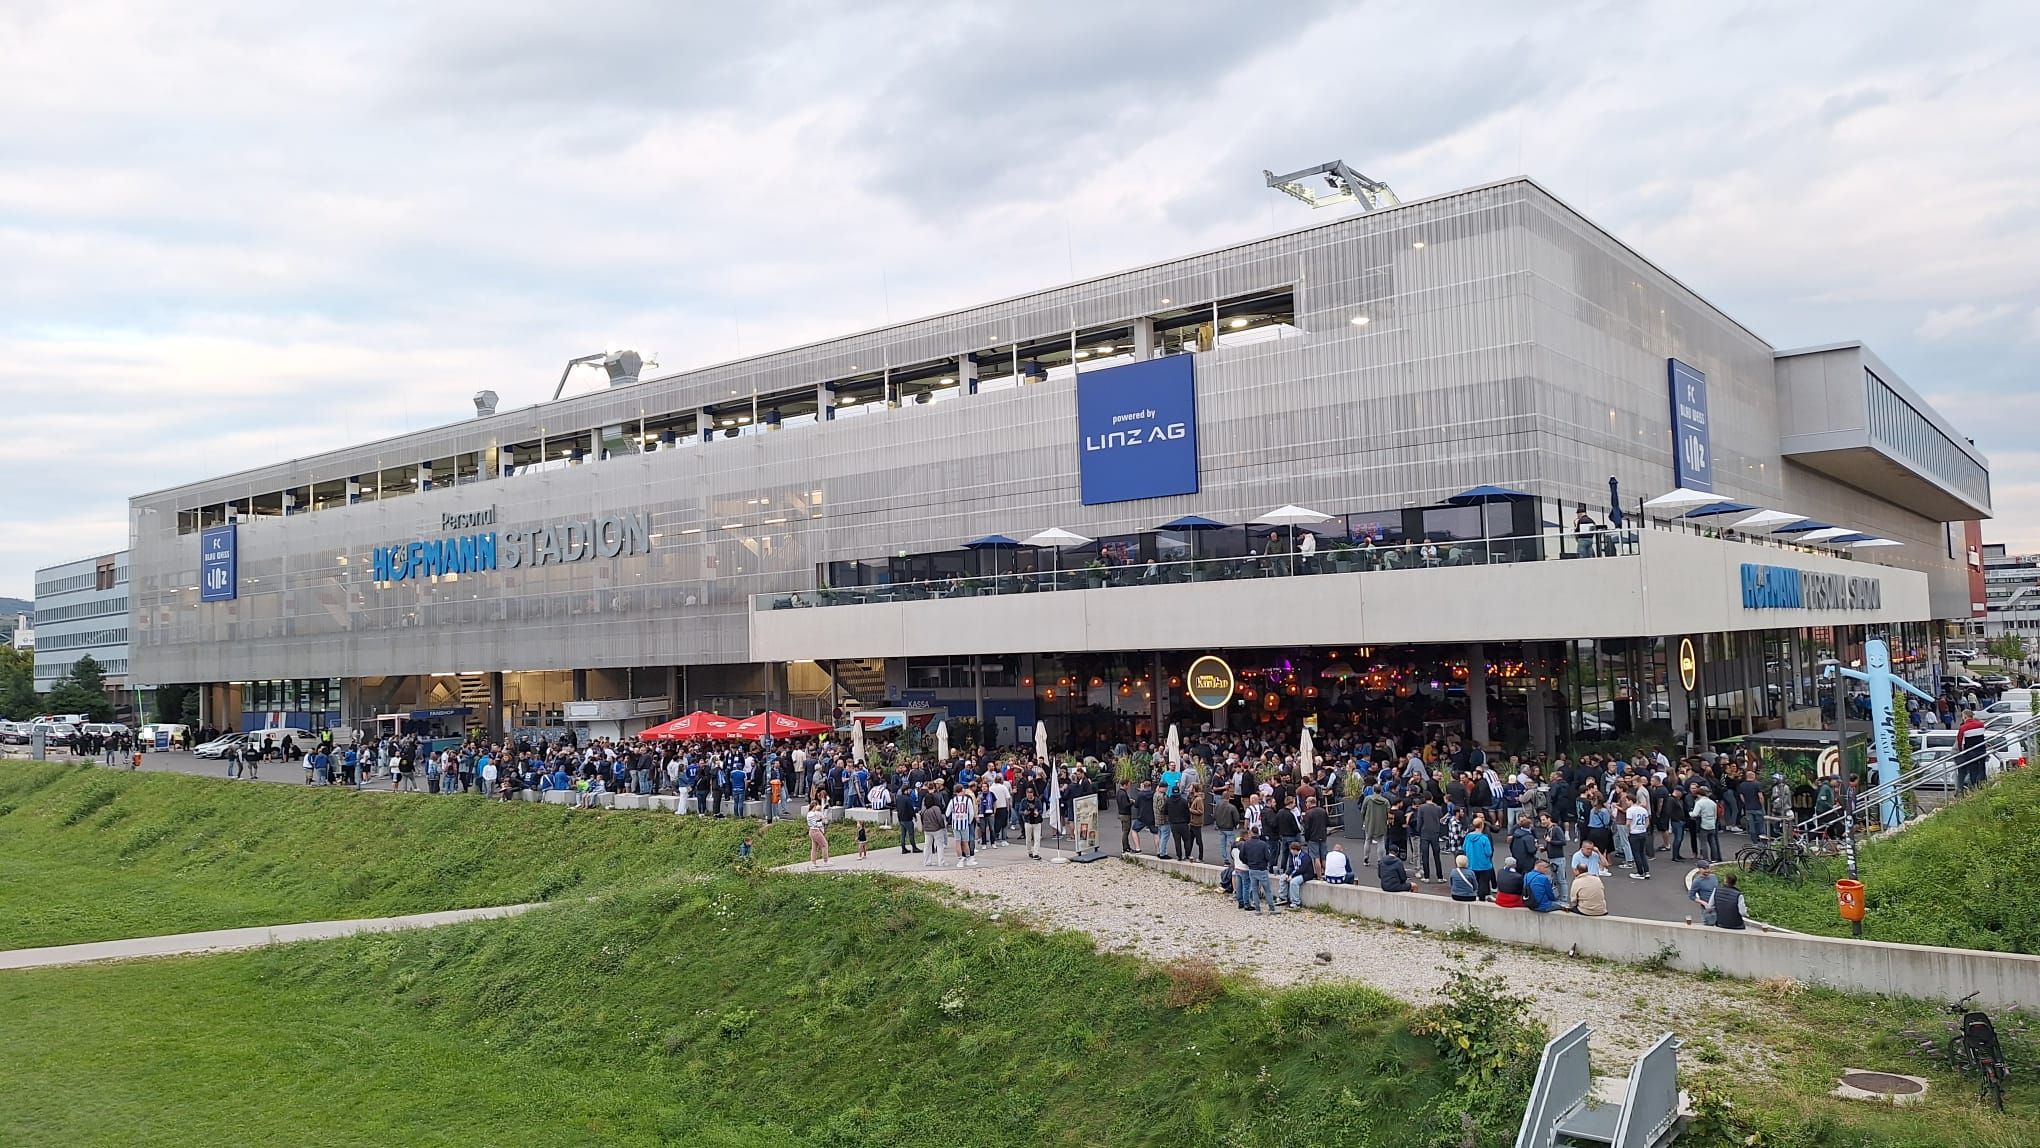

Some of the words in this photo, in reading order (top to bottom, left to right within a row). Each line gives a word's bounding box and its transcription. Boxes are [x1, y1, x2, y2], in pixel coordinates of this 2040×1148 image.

[1112, 409, 1145, 425] powered
[1146, 408, 1156, 419] by
[1086, 428, 1142, 451] LINZ
[1148, 422, 1186, 443] AG
[442, 503, 497, 531] Personal
[213, 538, 221, 549] FC
[373, 531, 497, 582] HOFMANN
[504, 510, 651, 570] STADION
[1740, 563, 1803, 609] HOFMANN
[908, 700, 929, 708] KASSA
